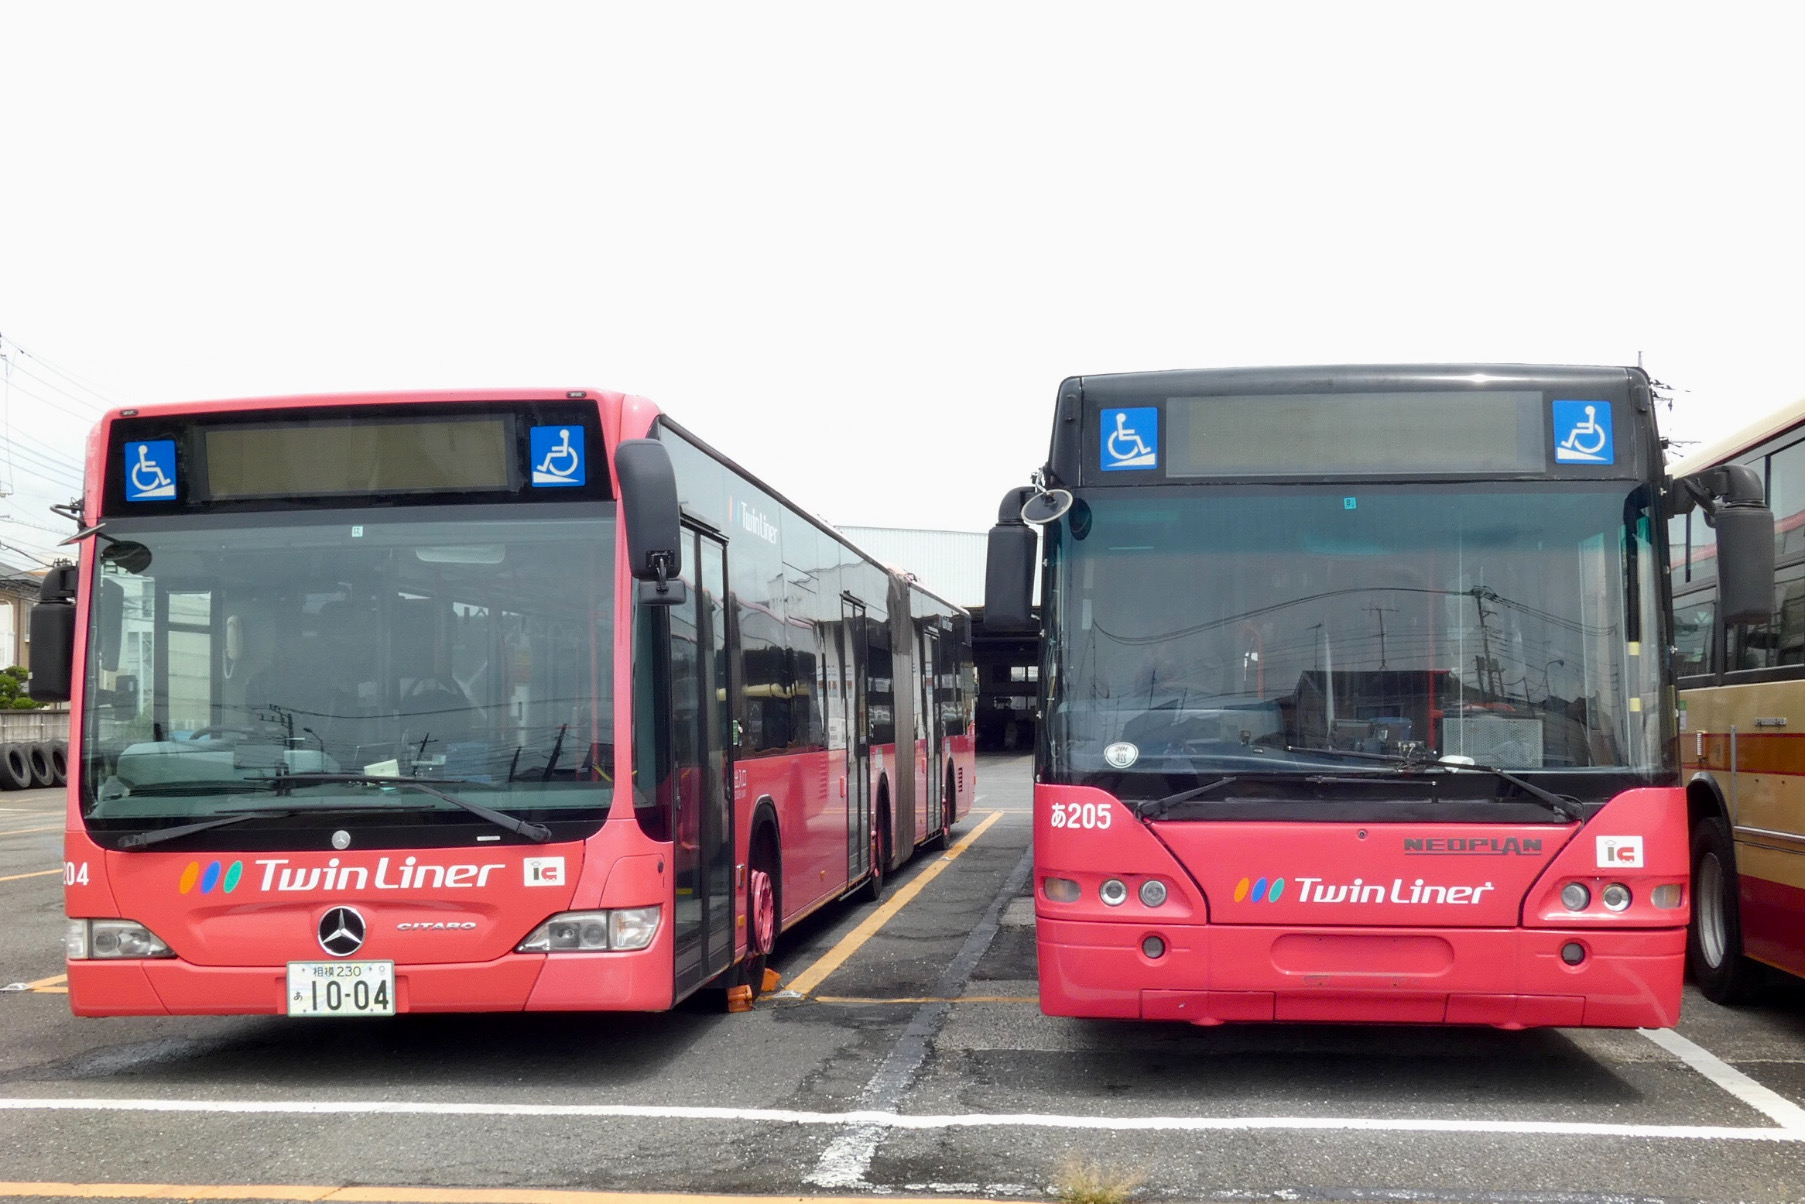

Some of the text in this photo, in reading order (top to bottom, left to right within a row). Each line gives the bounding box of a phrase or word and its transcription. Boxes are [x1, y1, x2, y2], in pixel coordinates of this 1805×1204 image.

[1051, 802, 1112, 829] あ205
[1403, 836, 1543, 855] NEOPLAN
[63, 861, 90, 886] 04
[396, 921, 477, 931] CITARO
[311, 979, 389, 1011] 10-04
